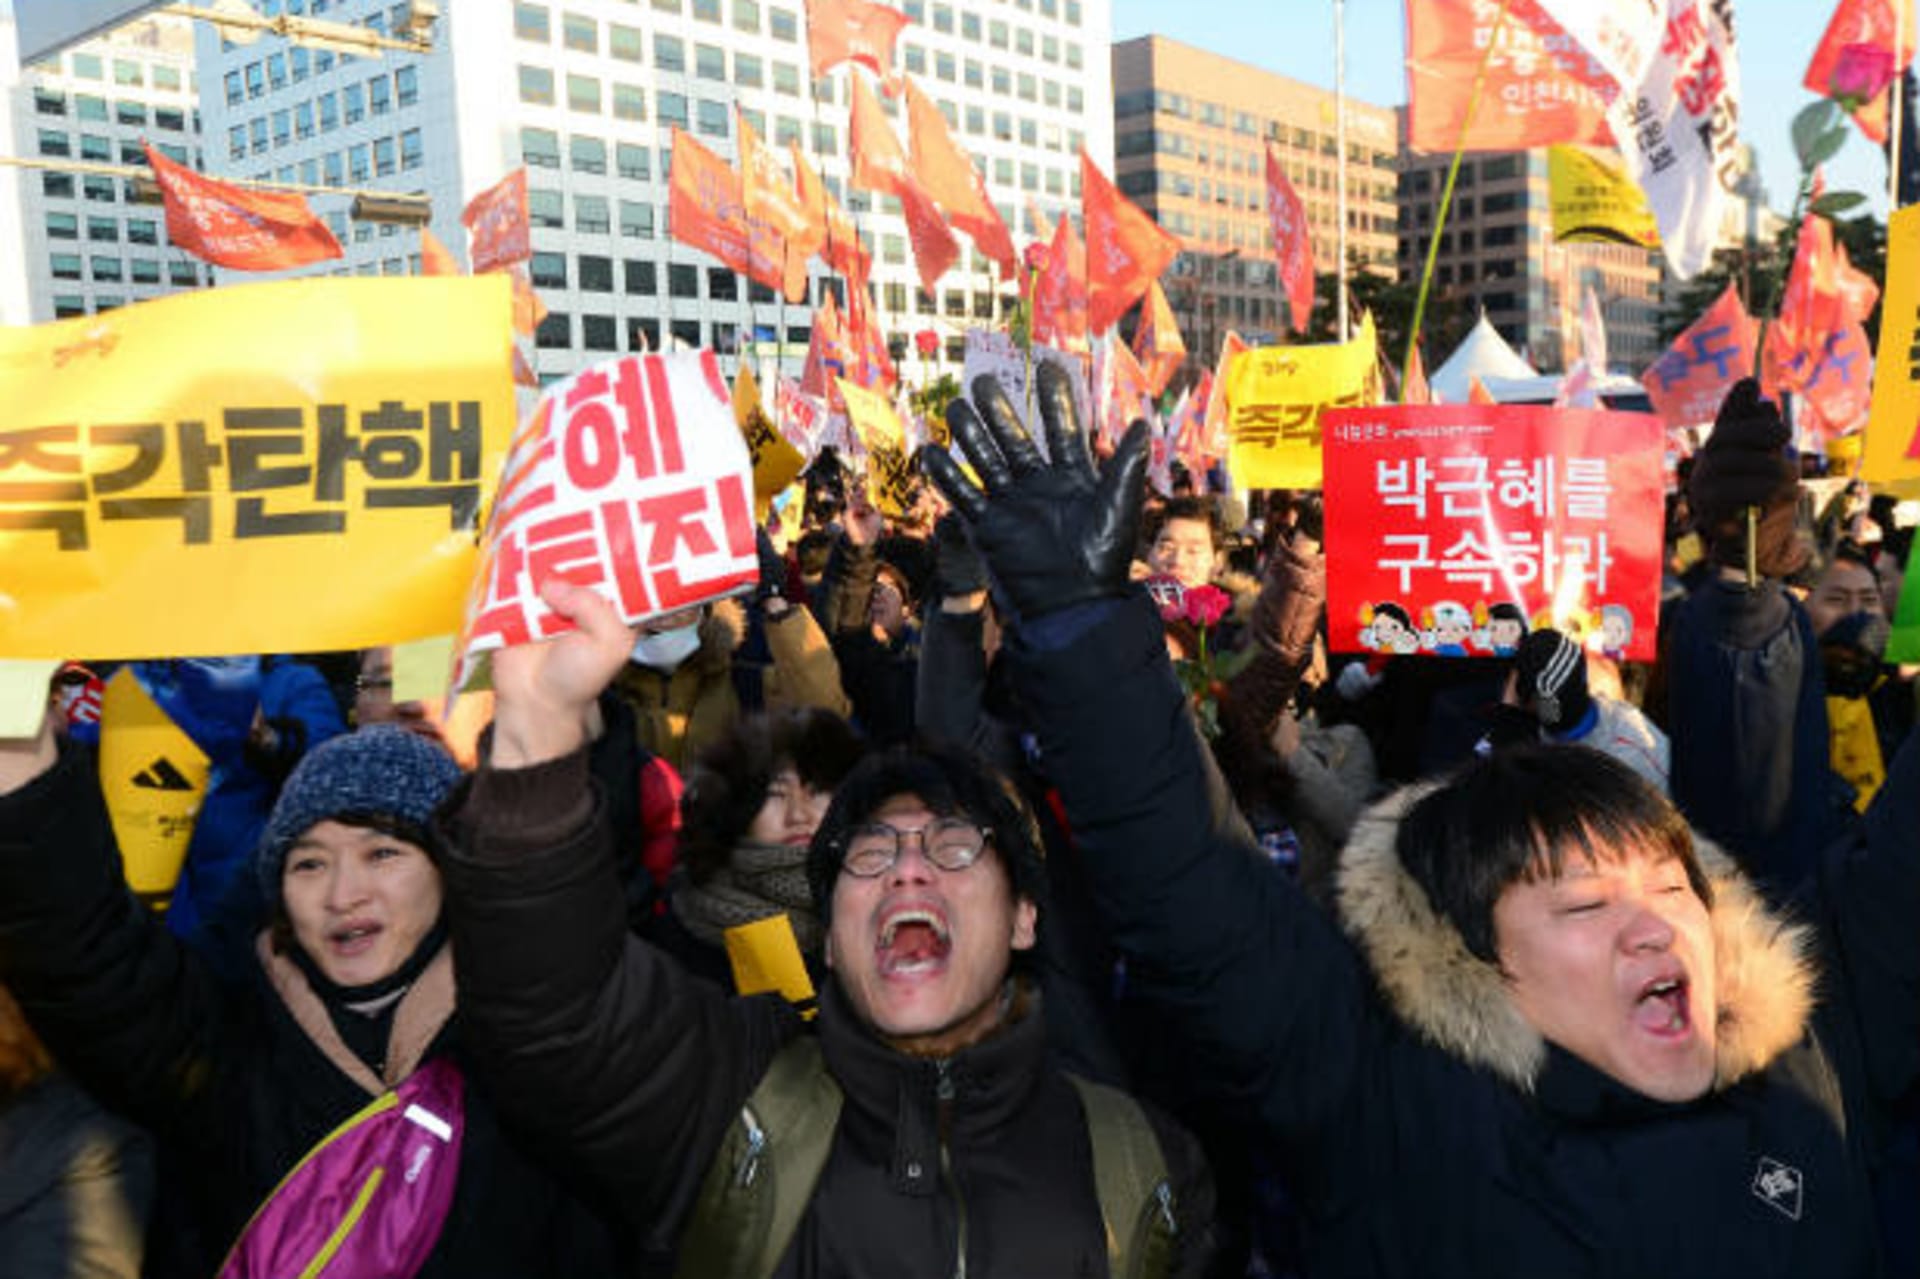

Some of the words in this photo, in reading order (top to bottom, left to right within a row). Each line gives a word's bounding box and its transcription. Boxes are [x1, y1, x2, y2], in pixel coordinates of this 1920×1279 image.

[0, 400, 483, 551] 즉각탄핵
[1376, 454, 1613, 519] 박근혜를
[1377, 530, 1613, 595] 구속하라
